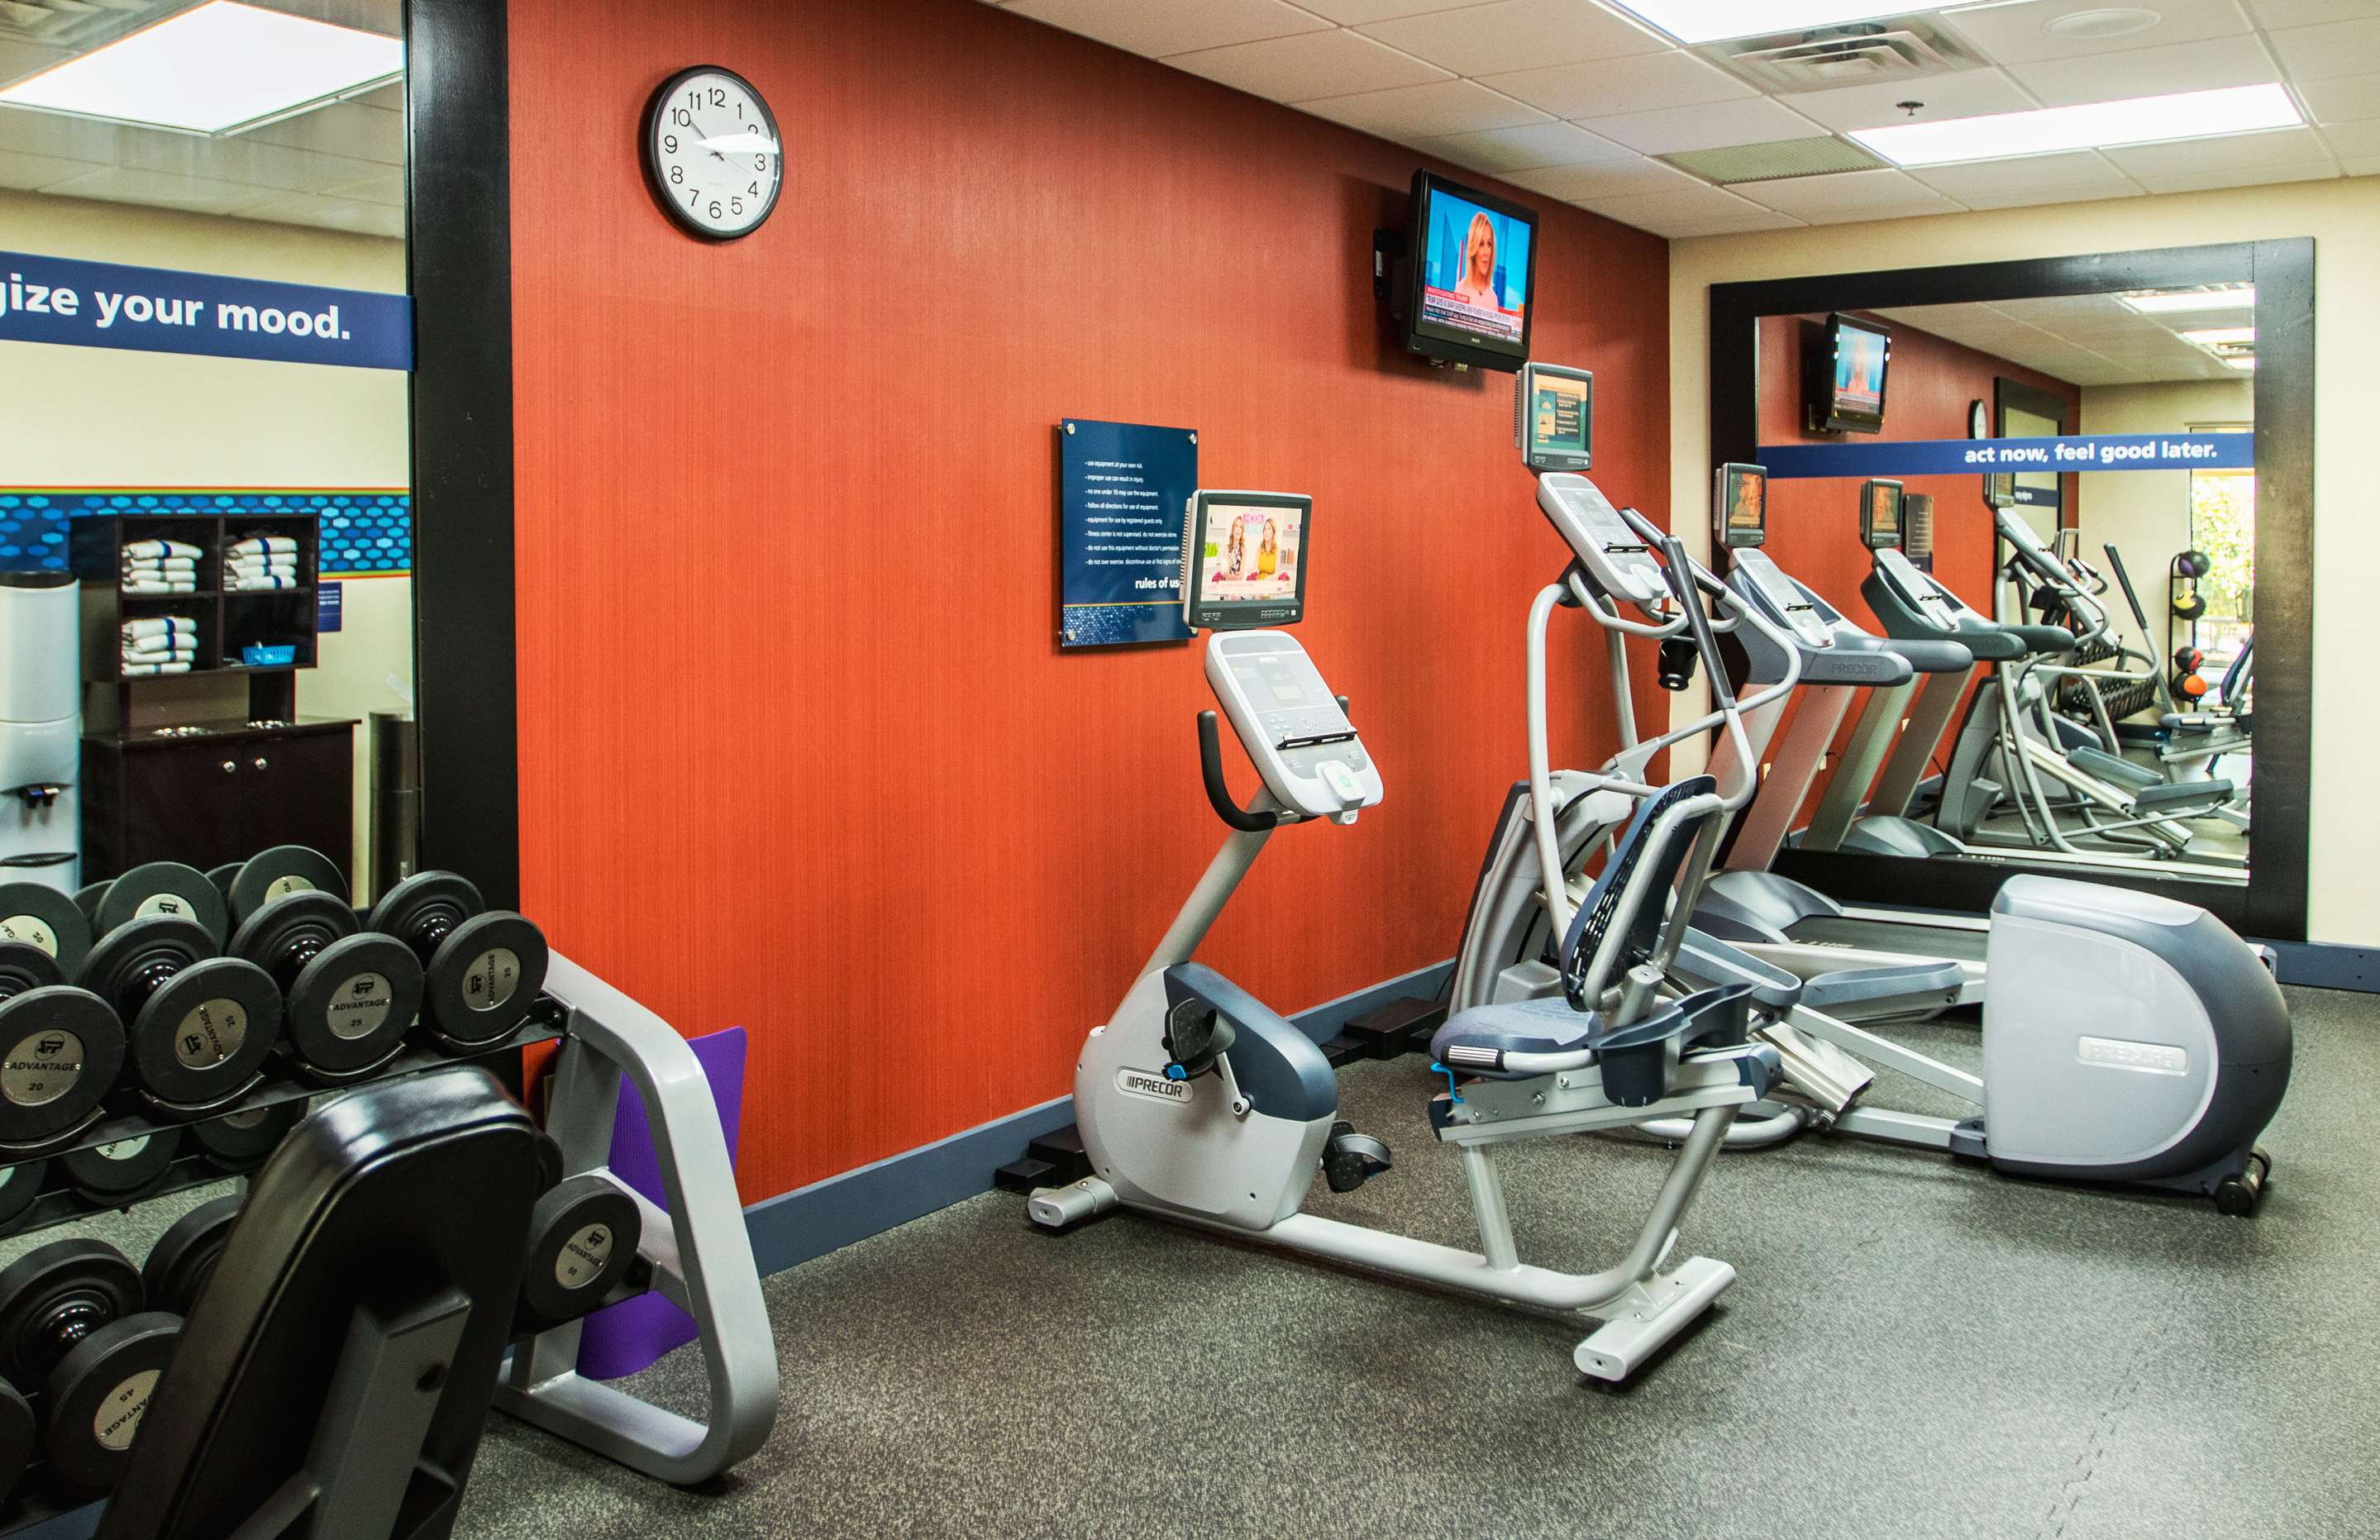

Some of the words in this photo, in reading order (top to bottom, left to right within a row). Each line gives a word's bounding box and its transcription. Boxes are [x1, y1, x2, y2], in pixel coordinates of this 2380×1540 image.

[689, 91, 700, 111] 11
[708, 88, 726, 107] 12
[671, 107, 690, 127] 10
[737, 103, 742, 119] 1
[665, 135, 677, 154] 9
[755, 153, 766, 171] 3
[670, 165, 683, 184] 8
[689, 188, 699, 207] 7
[747, 180, 758, 198] 4
[708, 201, 722, 219] 6
[731, 196, 742, 215] 5
[0, 273, 79, 318] ize
[93, 290, 204, 329] your
[217, 303, 351, 340] mood.
[1964, 447, 1995, 463] act
[2000, 448, 2049, 463] now,
[2054, 443, 2095, 461] feel
[2101, 441, 2156, 464] good
[2162, 441, 2217, 459] later.
[1135, 577, 1157, 589] rules
[1158, 576, 1168, 589] of
[1170, 579, 1180, 588] us
[503, 966, 511, 979] 25
[333, 999, 387, 1010] ADVANTAGE
[226, 1015, 236, 1027] 20
[351, 1018, 363, 1027] 25
[198, 1008, 223, 1056] ADVANTAGE
[9, 1061, 76, 1071] ADVANTAGE
[28, 1083, 44, 1091] 20
[1134, 1077, 1183, 1098] PRECOR
[567, 1242, 602, 1267] ADVANTAGE
